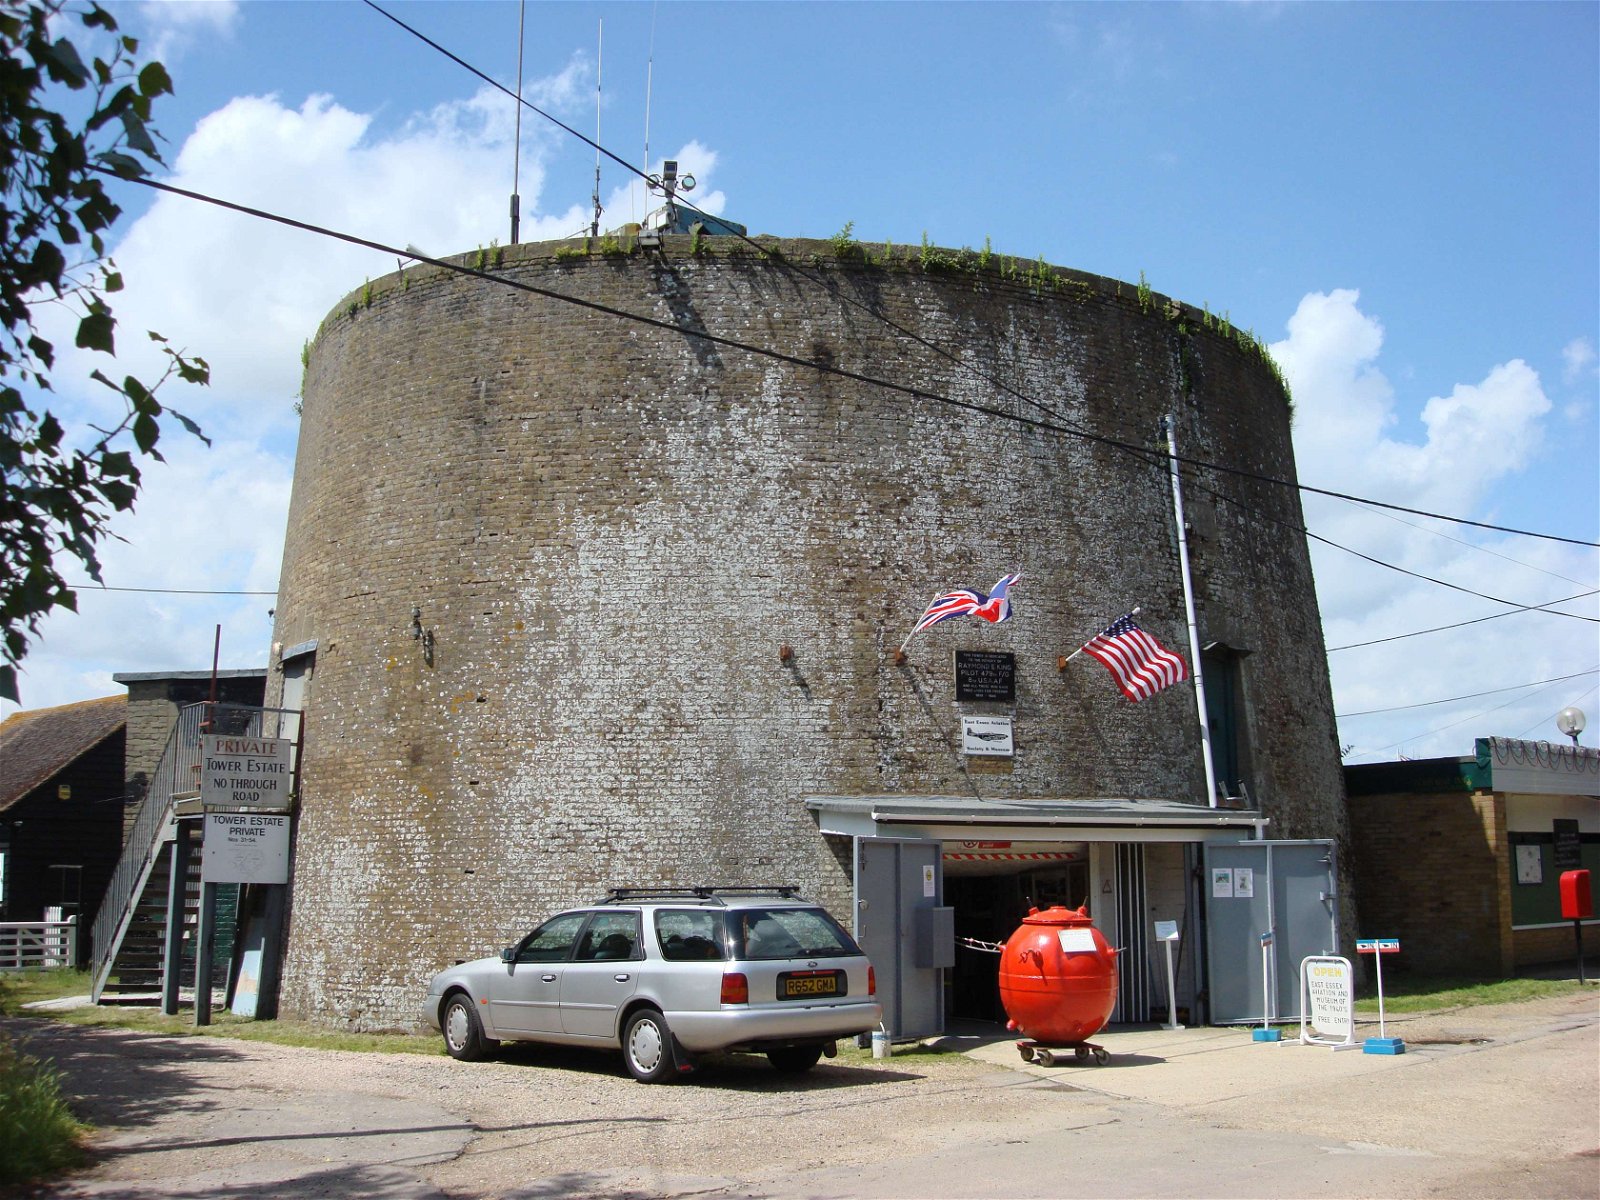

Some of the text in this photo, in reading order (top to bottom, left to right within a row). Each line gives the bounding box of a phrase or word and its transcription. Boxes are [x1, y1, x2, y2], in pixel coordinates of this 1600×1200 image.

[216, 740, 278, 754] PRIVATE
[214, 778, 277, 790] NO THROUGH
[232, 792, 260, 802] ROAD
[212, 816, 284, 826] TOWER ESTATE
[229, 826, 266, 836] PRIVATE
[1313, 967, 1342, 978] OPEN
[788, 978, 834, 992] R652 GMA
